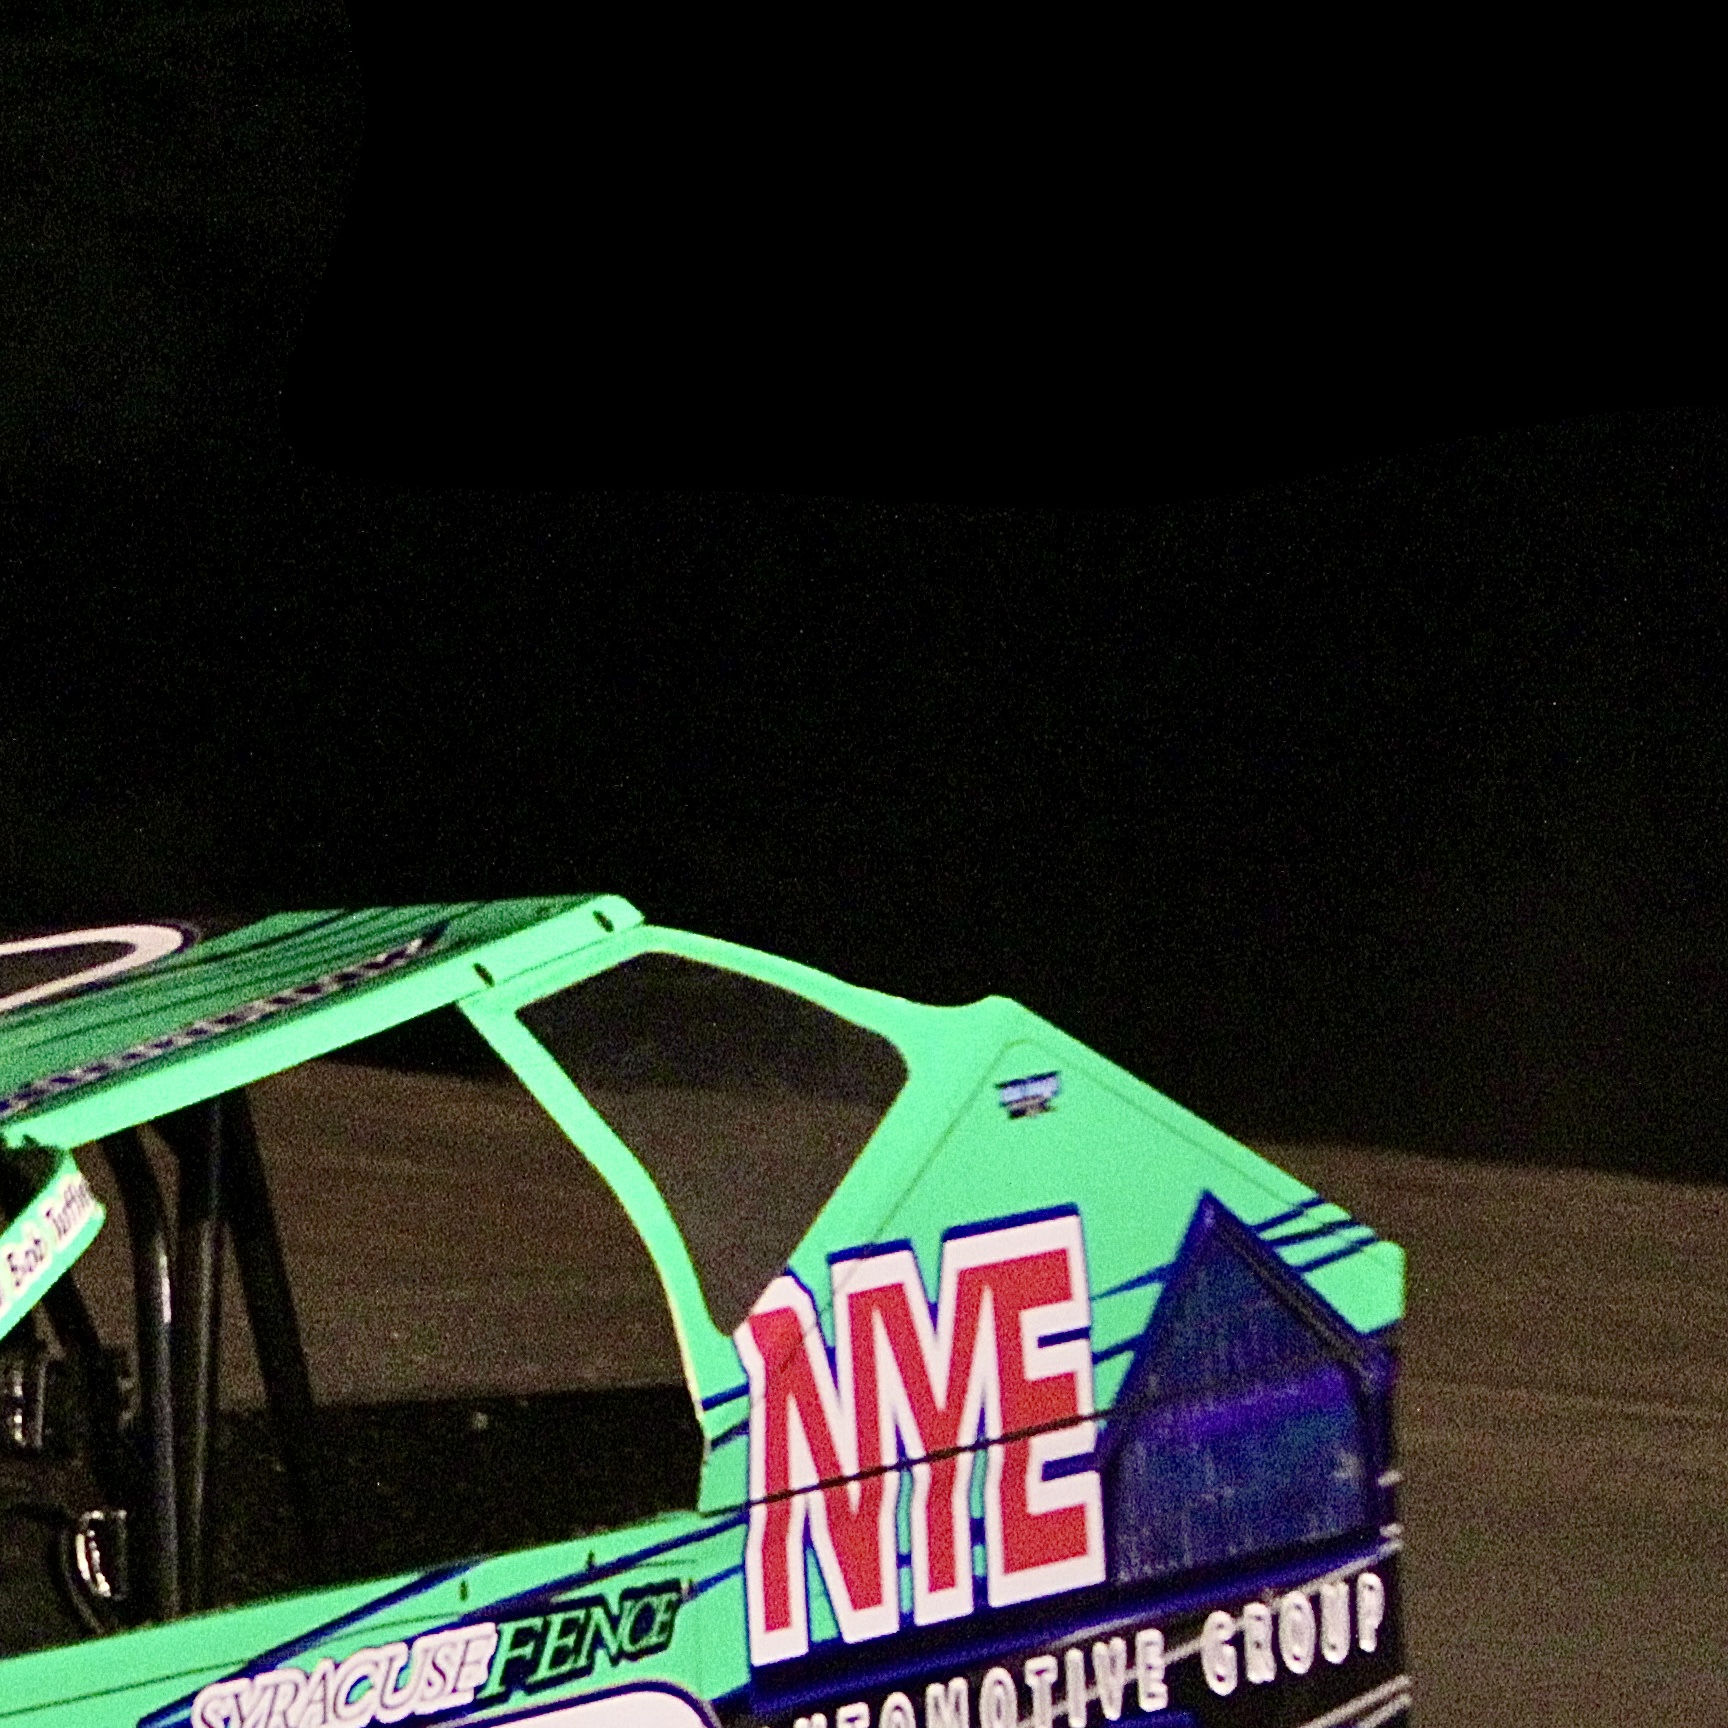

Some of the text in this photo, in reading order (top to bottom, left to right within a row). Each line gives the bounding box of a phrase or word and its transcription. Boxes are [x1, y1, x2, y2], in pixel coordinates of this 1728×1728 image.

[733, 1202, 1106, 1667] NYE
[478, 1582, 684, 1700] FENCE
[1200, 1572, 1386, 1697] GROUP
